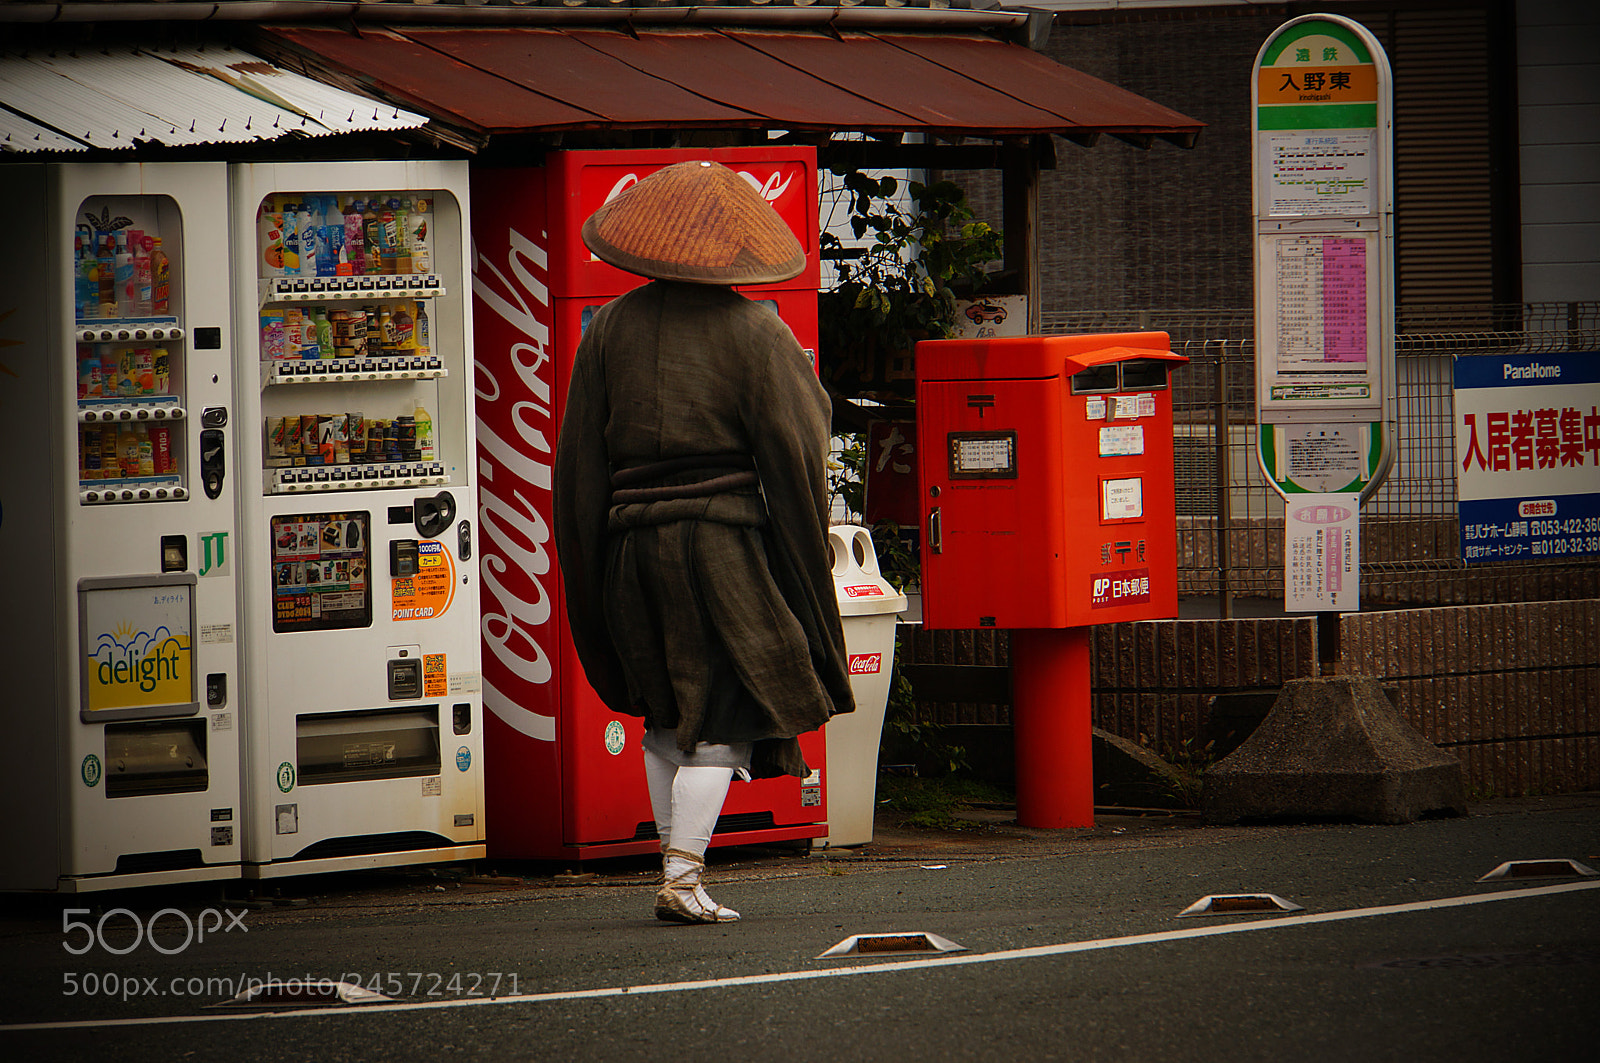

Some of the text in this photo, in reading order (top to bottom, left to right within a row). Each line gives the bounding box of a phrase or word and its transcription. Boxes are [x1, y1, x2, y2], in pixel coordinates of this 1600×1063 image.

[1296, 47, 1338, 62] 遠鉄
[1279, 71, 1352, 92] 入野東
[1504, 362, 1561, 380] PanaHome
[1462, 406, 1600, 473] 入居者募集中
[1300, 508, 1345, 521] お願い
[1523, 502, 1554, 515] お問合せ先
[199, 532, 229, 577] JT
[1465, 542, 1529, 559] 賃貸サポートセンター
[422, 556, 437, 565] カード
[1112, 577, 1150, 599] 日本郵便
[1092, 596, 1109, 604] POST
[295, 606, 311, 617] 2014
[392, 606, 434, 619] POINT CARD
[98, 648, 180, 692] delight
[850, 655, 880, 673] Coca-Cola
